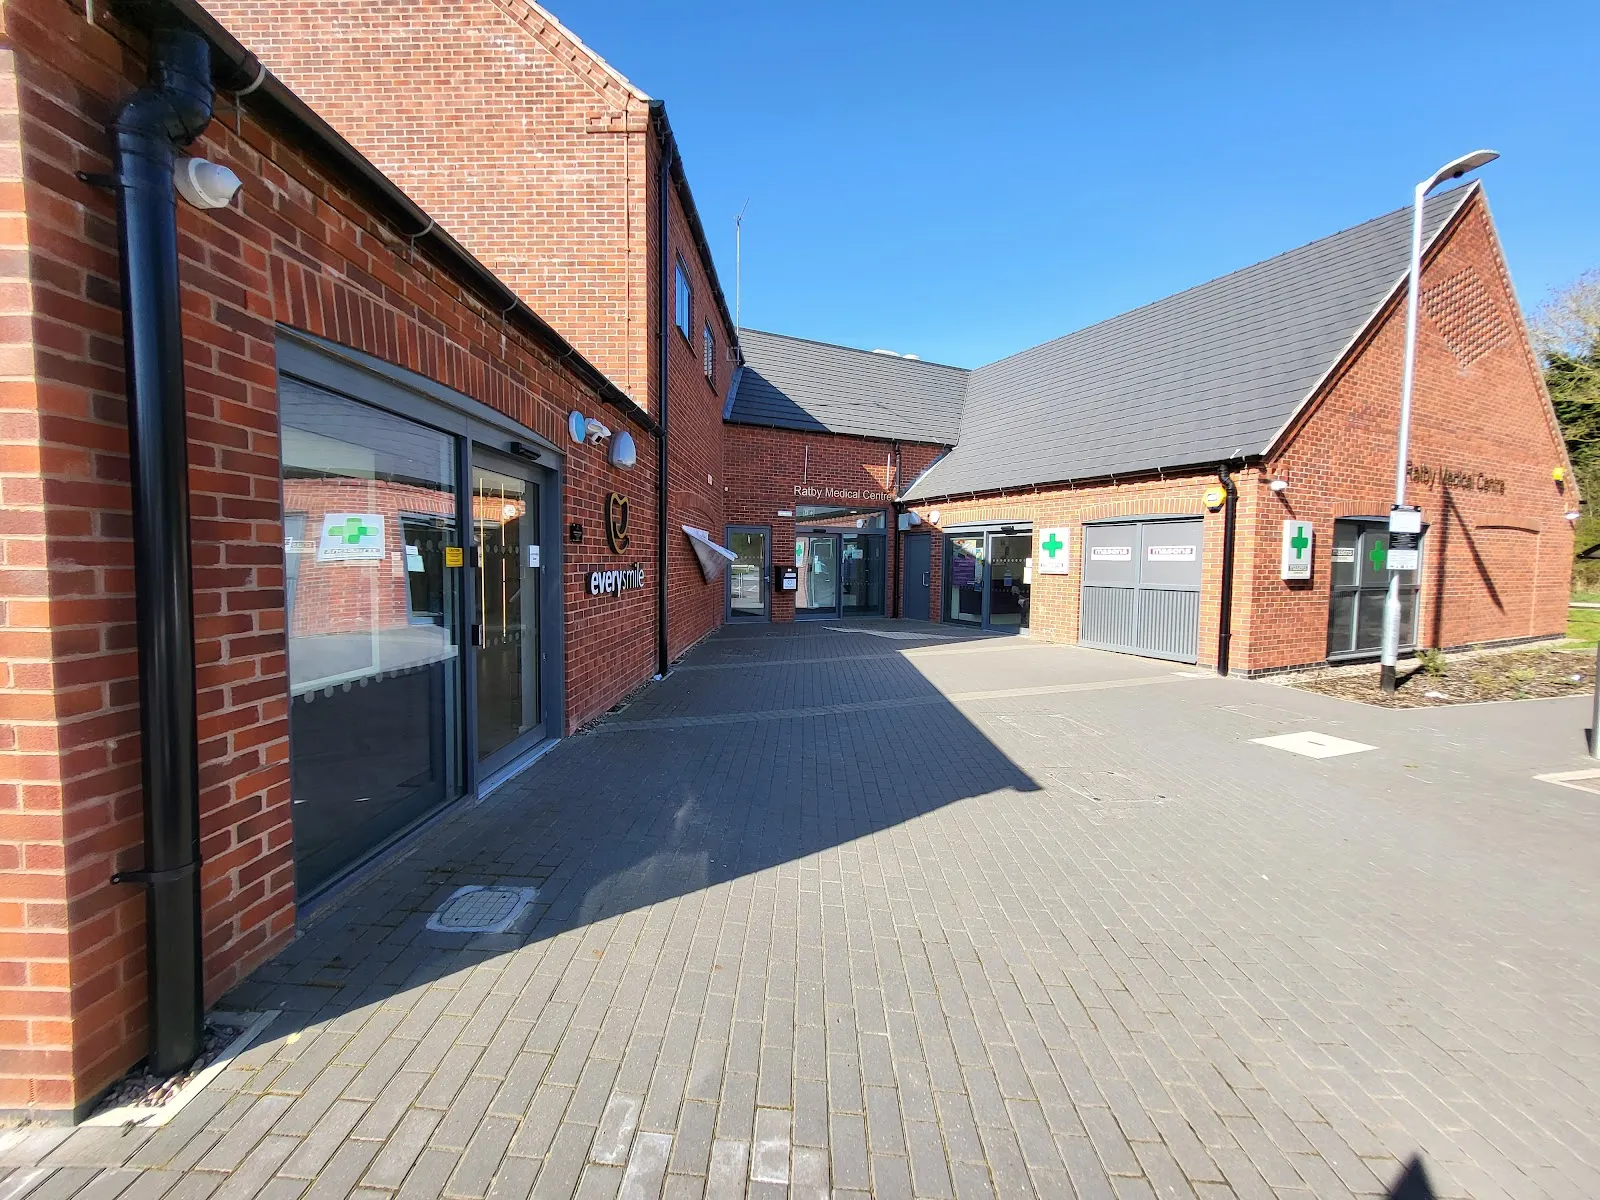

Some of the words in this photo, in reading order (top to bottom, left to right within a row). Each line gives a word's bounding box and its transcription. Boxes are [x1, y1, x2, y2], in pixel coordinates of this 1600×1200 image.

[794, 485, 823, 499] Ratby
[825, 487, 860, 499] Medical
[862, 490, 892, 501] Centre
[1477, 472, 1505, 496] Centre
[590, 562, 645, 597] everysmile
